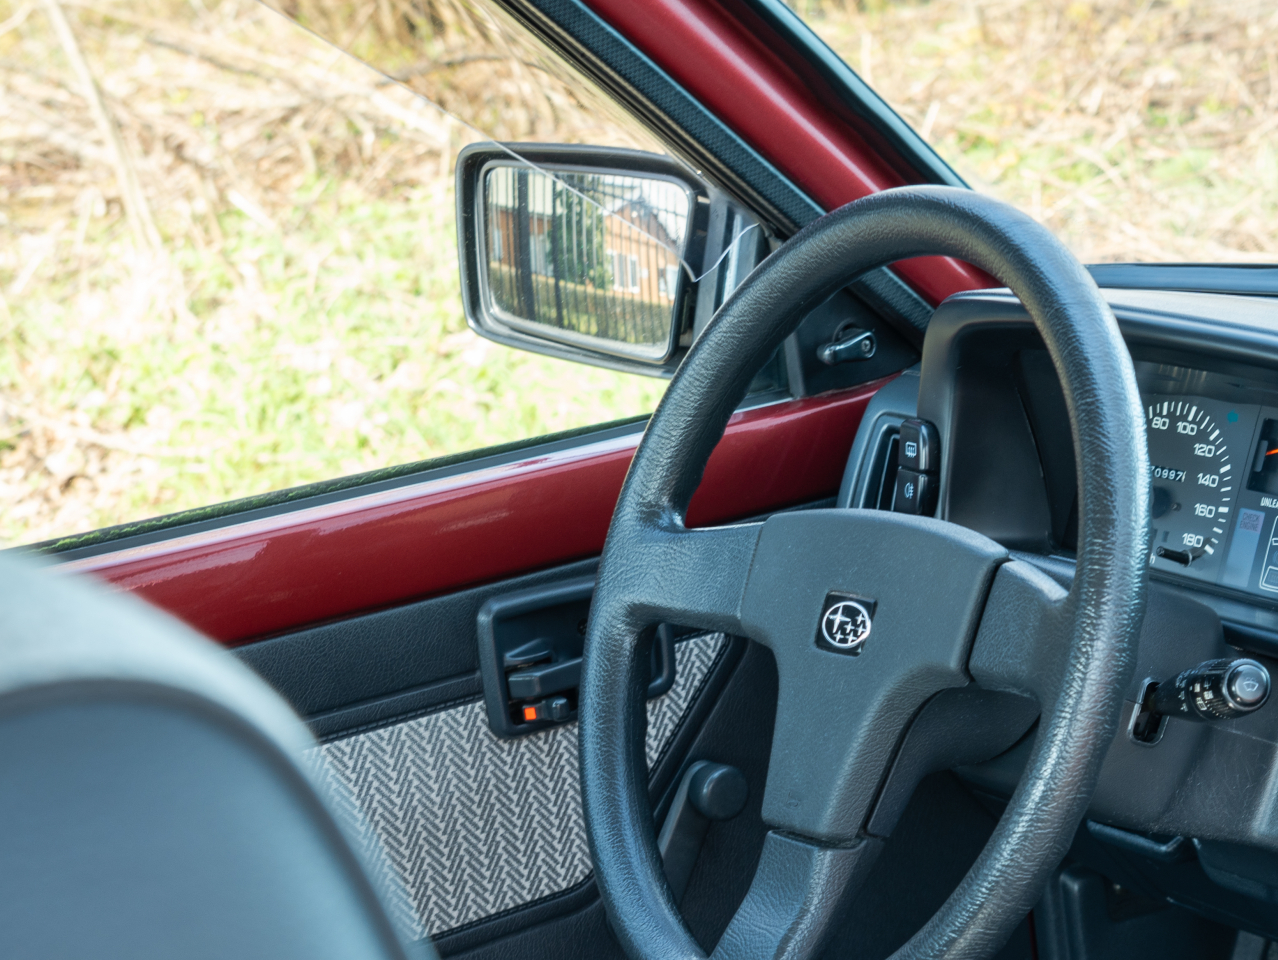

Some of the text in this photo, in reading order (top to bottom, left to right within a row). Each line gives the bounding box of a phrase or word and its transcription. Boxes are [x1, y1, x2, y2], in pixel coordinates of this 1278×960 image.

[1152, 417, 1169, 430] 80
[1176, 421, 1197, 435] 100
[1193, 443, 1215, 458] 120
[1197, 473, 1219, 488] 140
[1194, 503, 1215, 518] 160
[1182, 533, 1203, 548] 180
